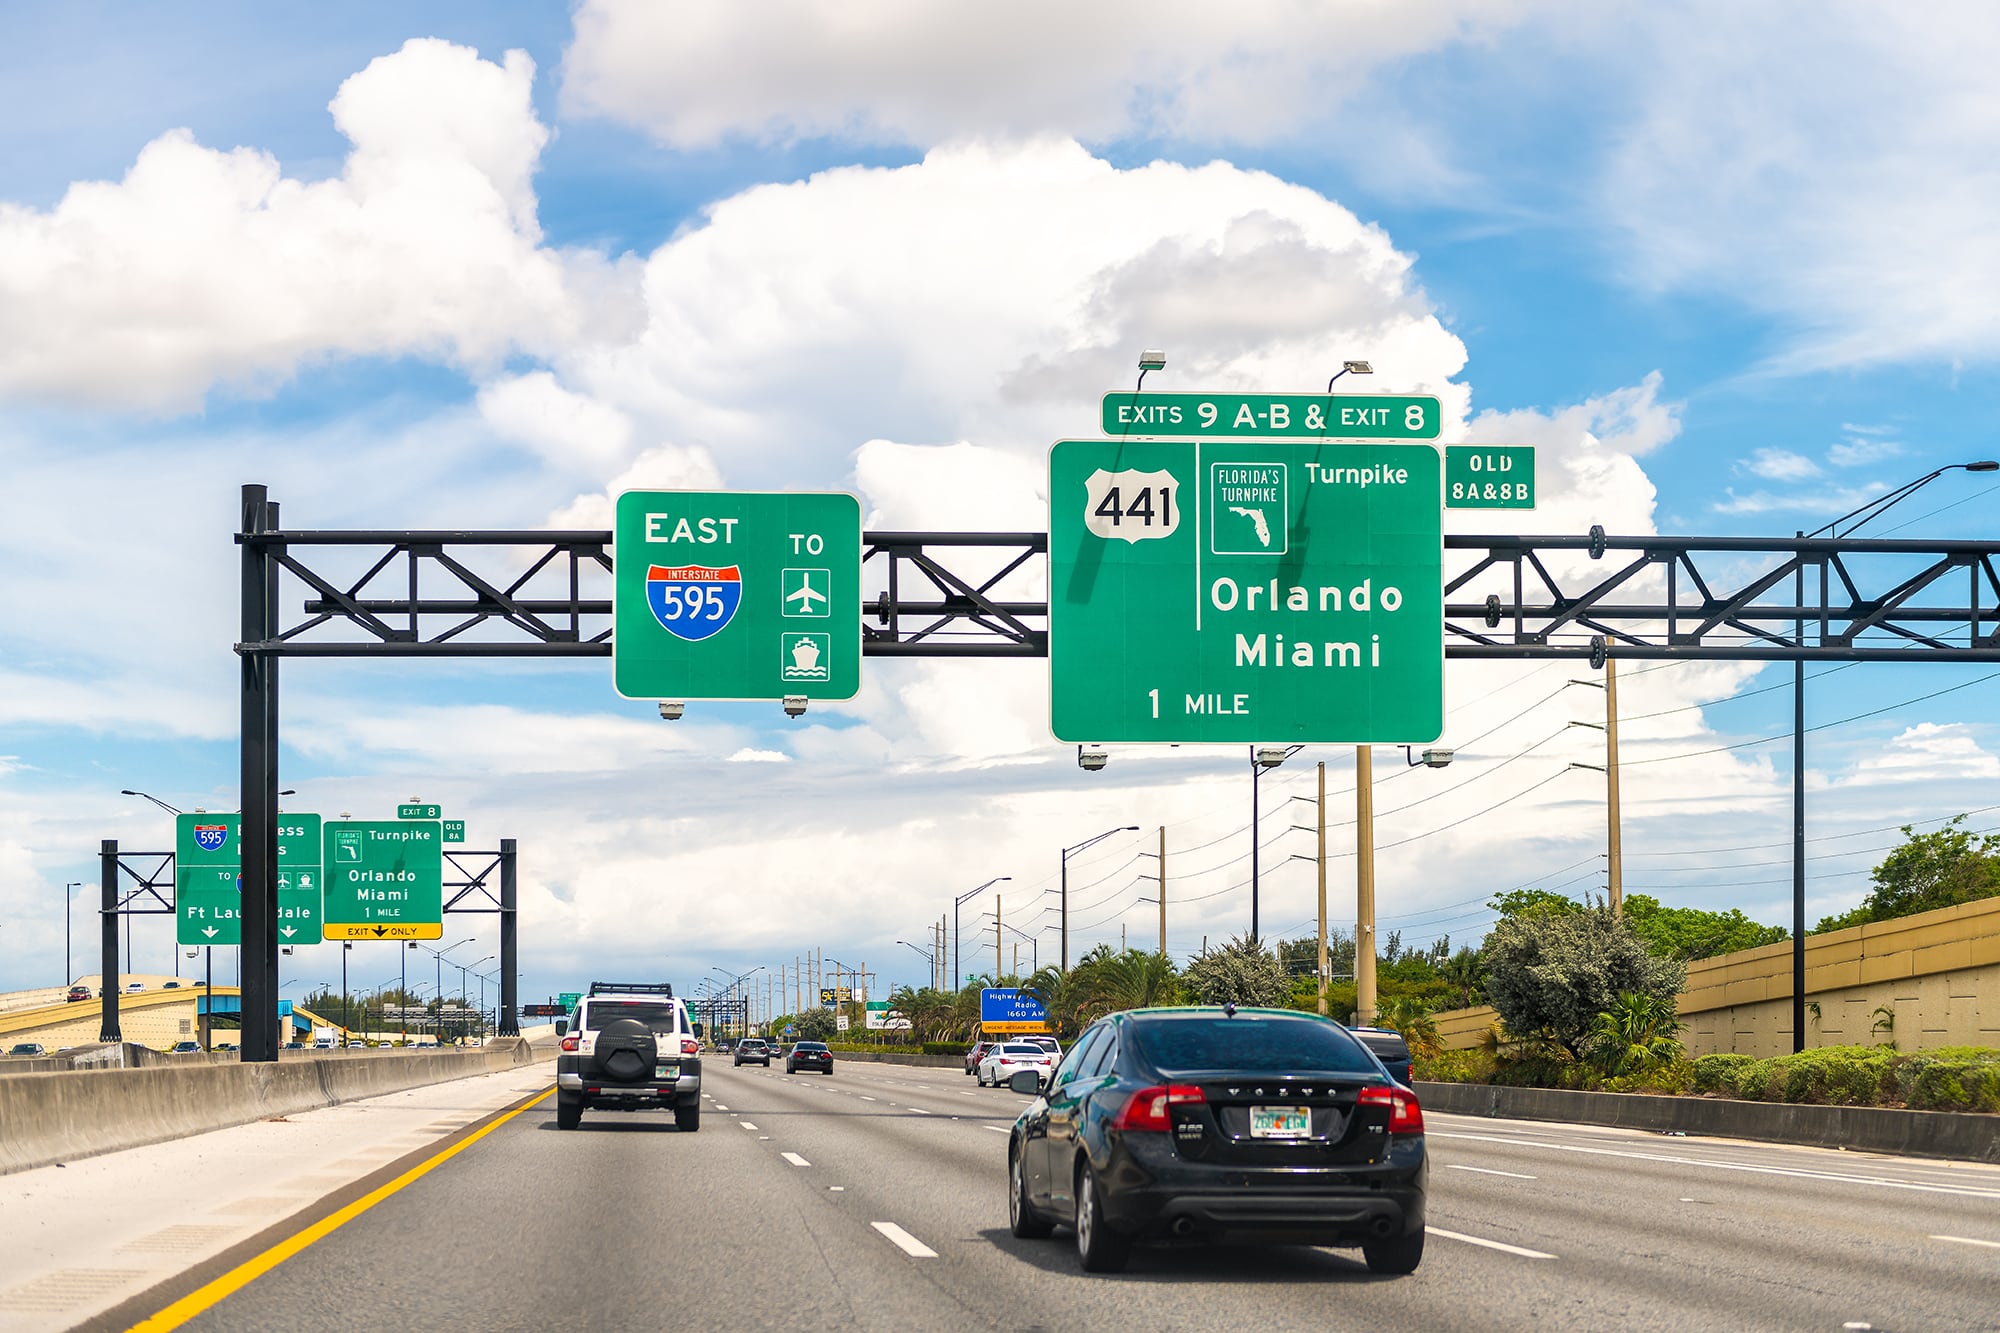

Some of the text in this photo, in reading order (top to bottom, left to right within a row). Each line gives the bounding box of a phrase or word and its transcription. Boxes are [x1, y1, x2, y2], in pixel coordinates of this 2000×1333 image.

[1118, 402, 1425, 431] EXITS 9 A-B & EXIT 8
[1469, 454, 1513, 472] OLD
[1218, 469, 1280, 485] FLORIDA'S
[1304, 462, 1409, 489] Turnpike
[1221, 487, 1277, 502] TURNPIKE
[1452, 482, 1529, 501] 8A&8B
[1094, 486, 1170, 527] 441
[645, 512, 739, 544] EAST
[788, 534, 824, 556] TO
[667, 570, 720, 580] INTERSTATE
[1211, 576, 1403, 612] Orlando
[664, 585, 724, 621] 595
[1235, 633, 1380, 667] Miami
[1148, 688, 1249, 719] 1 MILE
[402, 807, 436, 817] EXIT 8
[200, 831, 222, 845] 595
[368, 830, 431, 842] Turnpike
[218, 872, 231, 880] TO
[348, 870, 416, 882] Orlando
[357, 888, 408, 901] Miami
[187, 906, 205, 919] Ft
[364, 906, 401, 918] 1 MILE
[347, 927, 418, 936] EXIT ONLY
[1015, 1001, 1037, 1009] Radio
